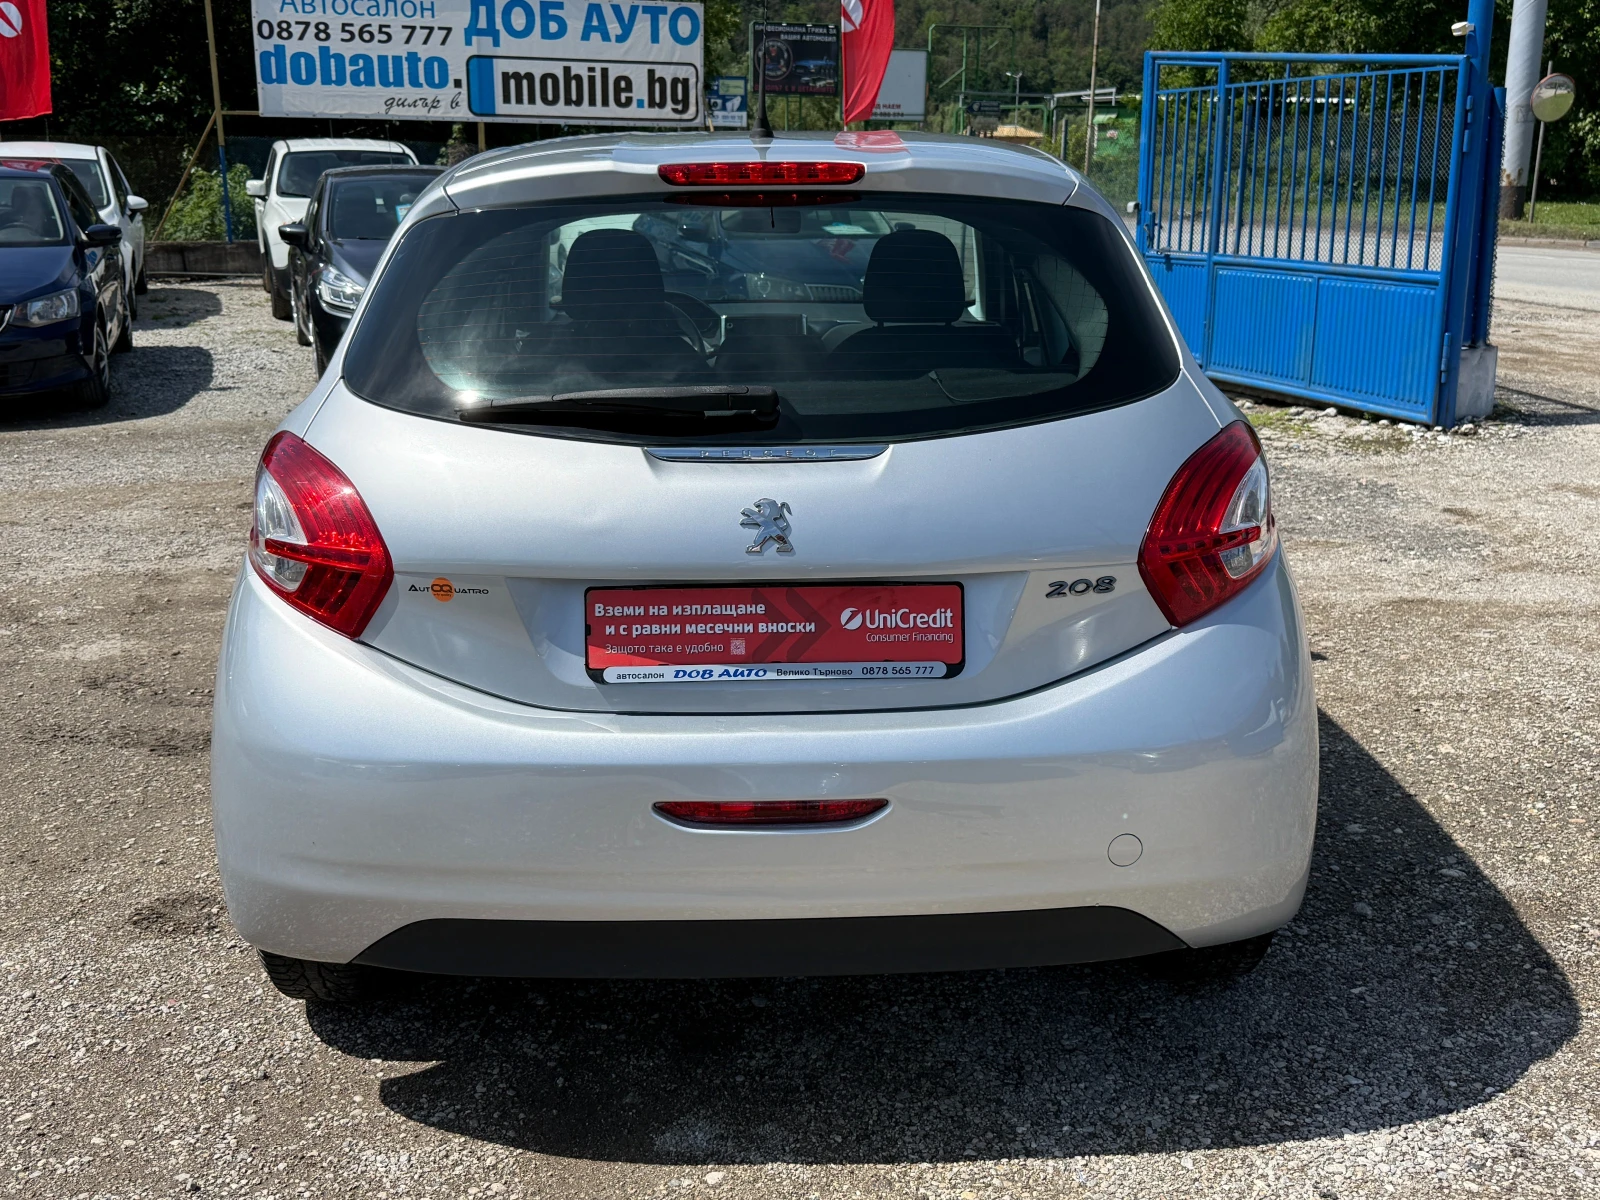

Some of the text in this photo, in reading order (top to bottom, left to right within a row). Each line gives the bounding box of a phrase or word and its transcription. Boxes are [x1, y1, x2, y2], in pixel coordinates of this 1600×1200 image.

[279, 0, 436, 18] Автосалон
[257, 19, 453, 46] 0878 565 777
[464, 0, 701, 47] ДОБ АУТО
[501, 66, 690, 115] mobile.bg
[384, 95, 442, 114] дилър
[701, 449, 836, 458] PEUGEOT
[1045, 575, 1117, 598] 208
[594, 603, 766, 617] Вземи на изплащане
[865, 608, 953, 629] UniCredit
[605, 621, 816, 638] и с равни месечни вноски
[866, 631, 954, 643] Consumer Financing
[605, 642, 724, 655] Защото така е удобно
[616, 671, 665, 680] автосалон
[776, 668, 810, 677] Велико
[812, 668, 853, 677] Търново
[861, 666, 889, 675] 0878
[891, 666, 912, 675] 565
[915, 666, 935, 675] 777
